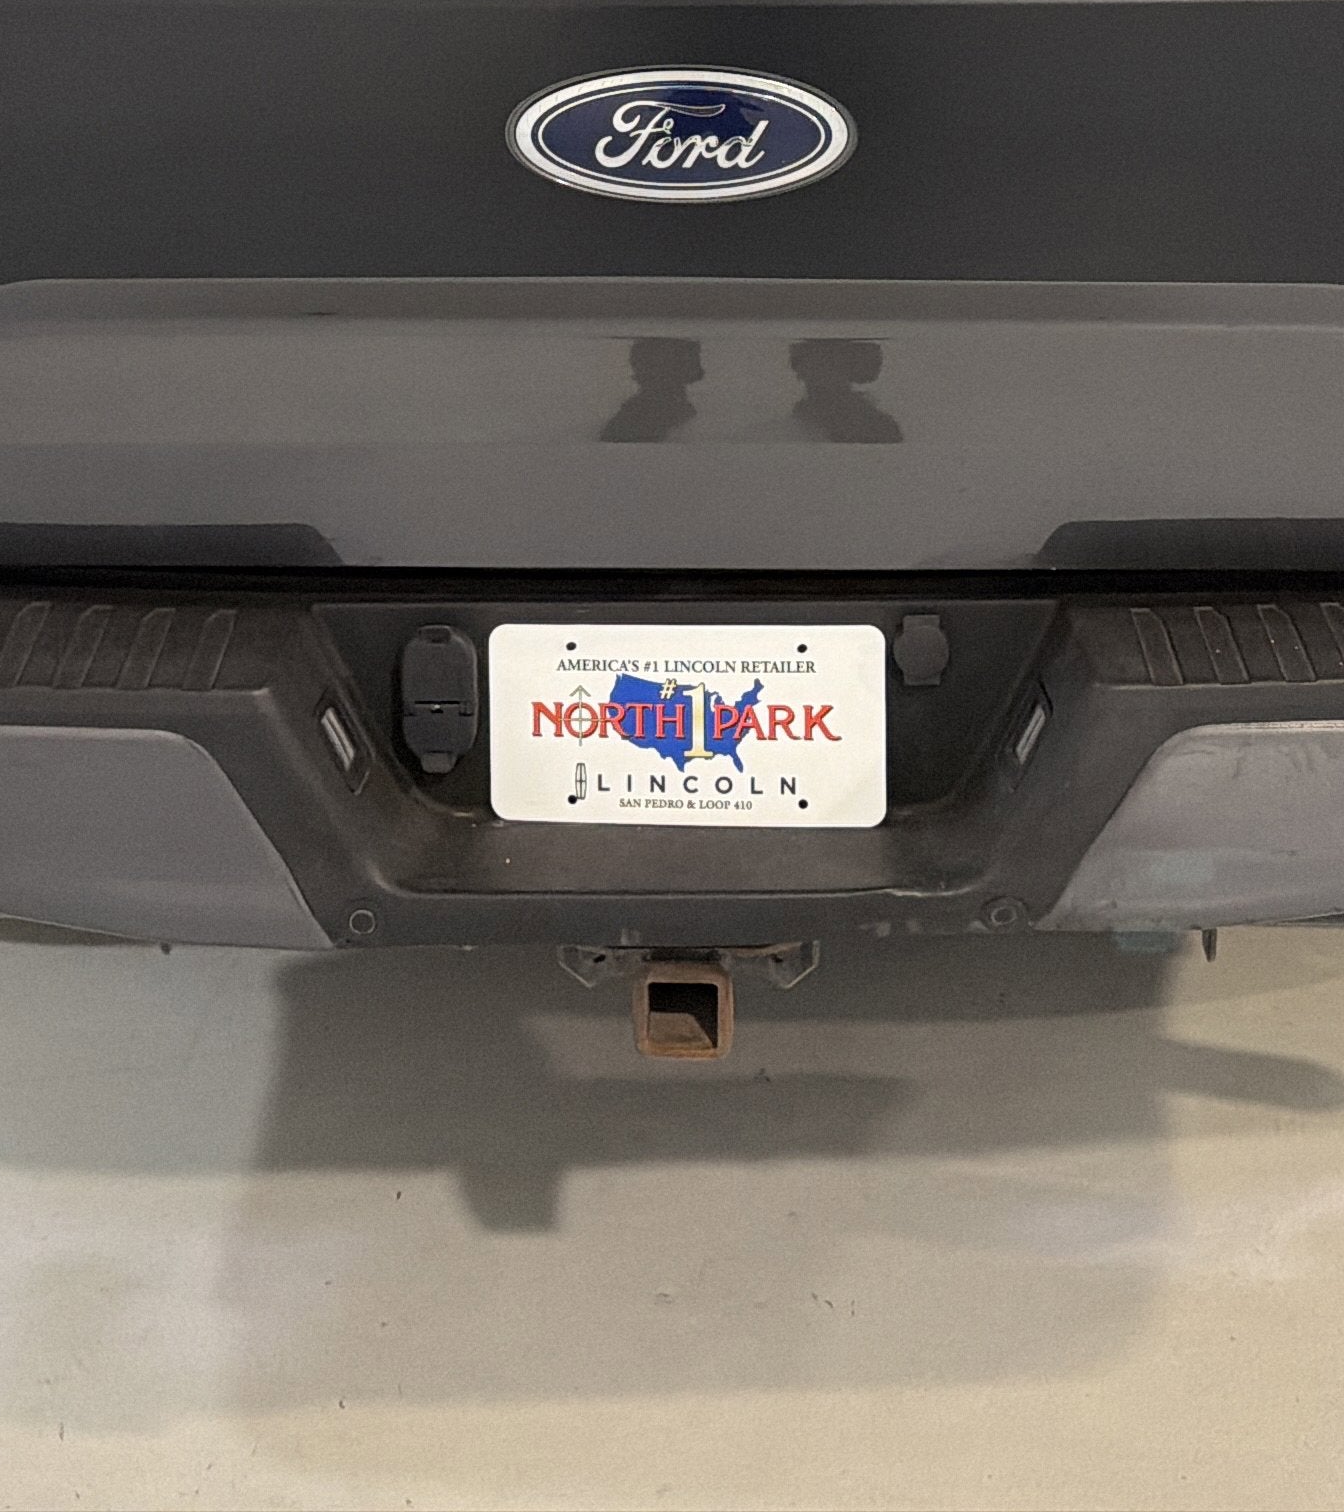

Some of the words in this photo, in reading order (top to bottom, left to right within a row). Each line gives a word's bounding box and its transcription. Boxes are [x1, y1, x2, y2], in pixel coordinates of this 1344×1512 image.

[594, 100, 769, 169] Ford
[556, 658, 640, 673] AMERICA'S
[643, 660, 659, 673] #1
[663, 659, 737, 674] LINCOLN
[740, 660, 817, 675] RETAILER
[531, 701, 685, 741] NORTH
[712, 702, 843, 742] PARK
[597, 773, 797, 796] LINCOLN
[618, 798, 642, 808] SAN
[644, 798, 684, 809] PEDRO
[686, 799, 697, 809] &
[699, 799, 731, 810] LOOP
[733, 800, 753, 811] 410
